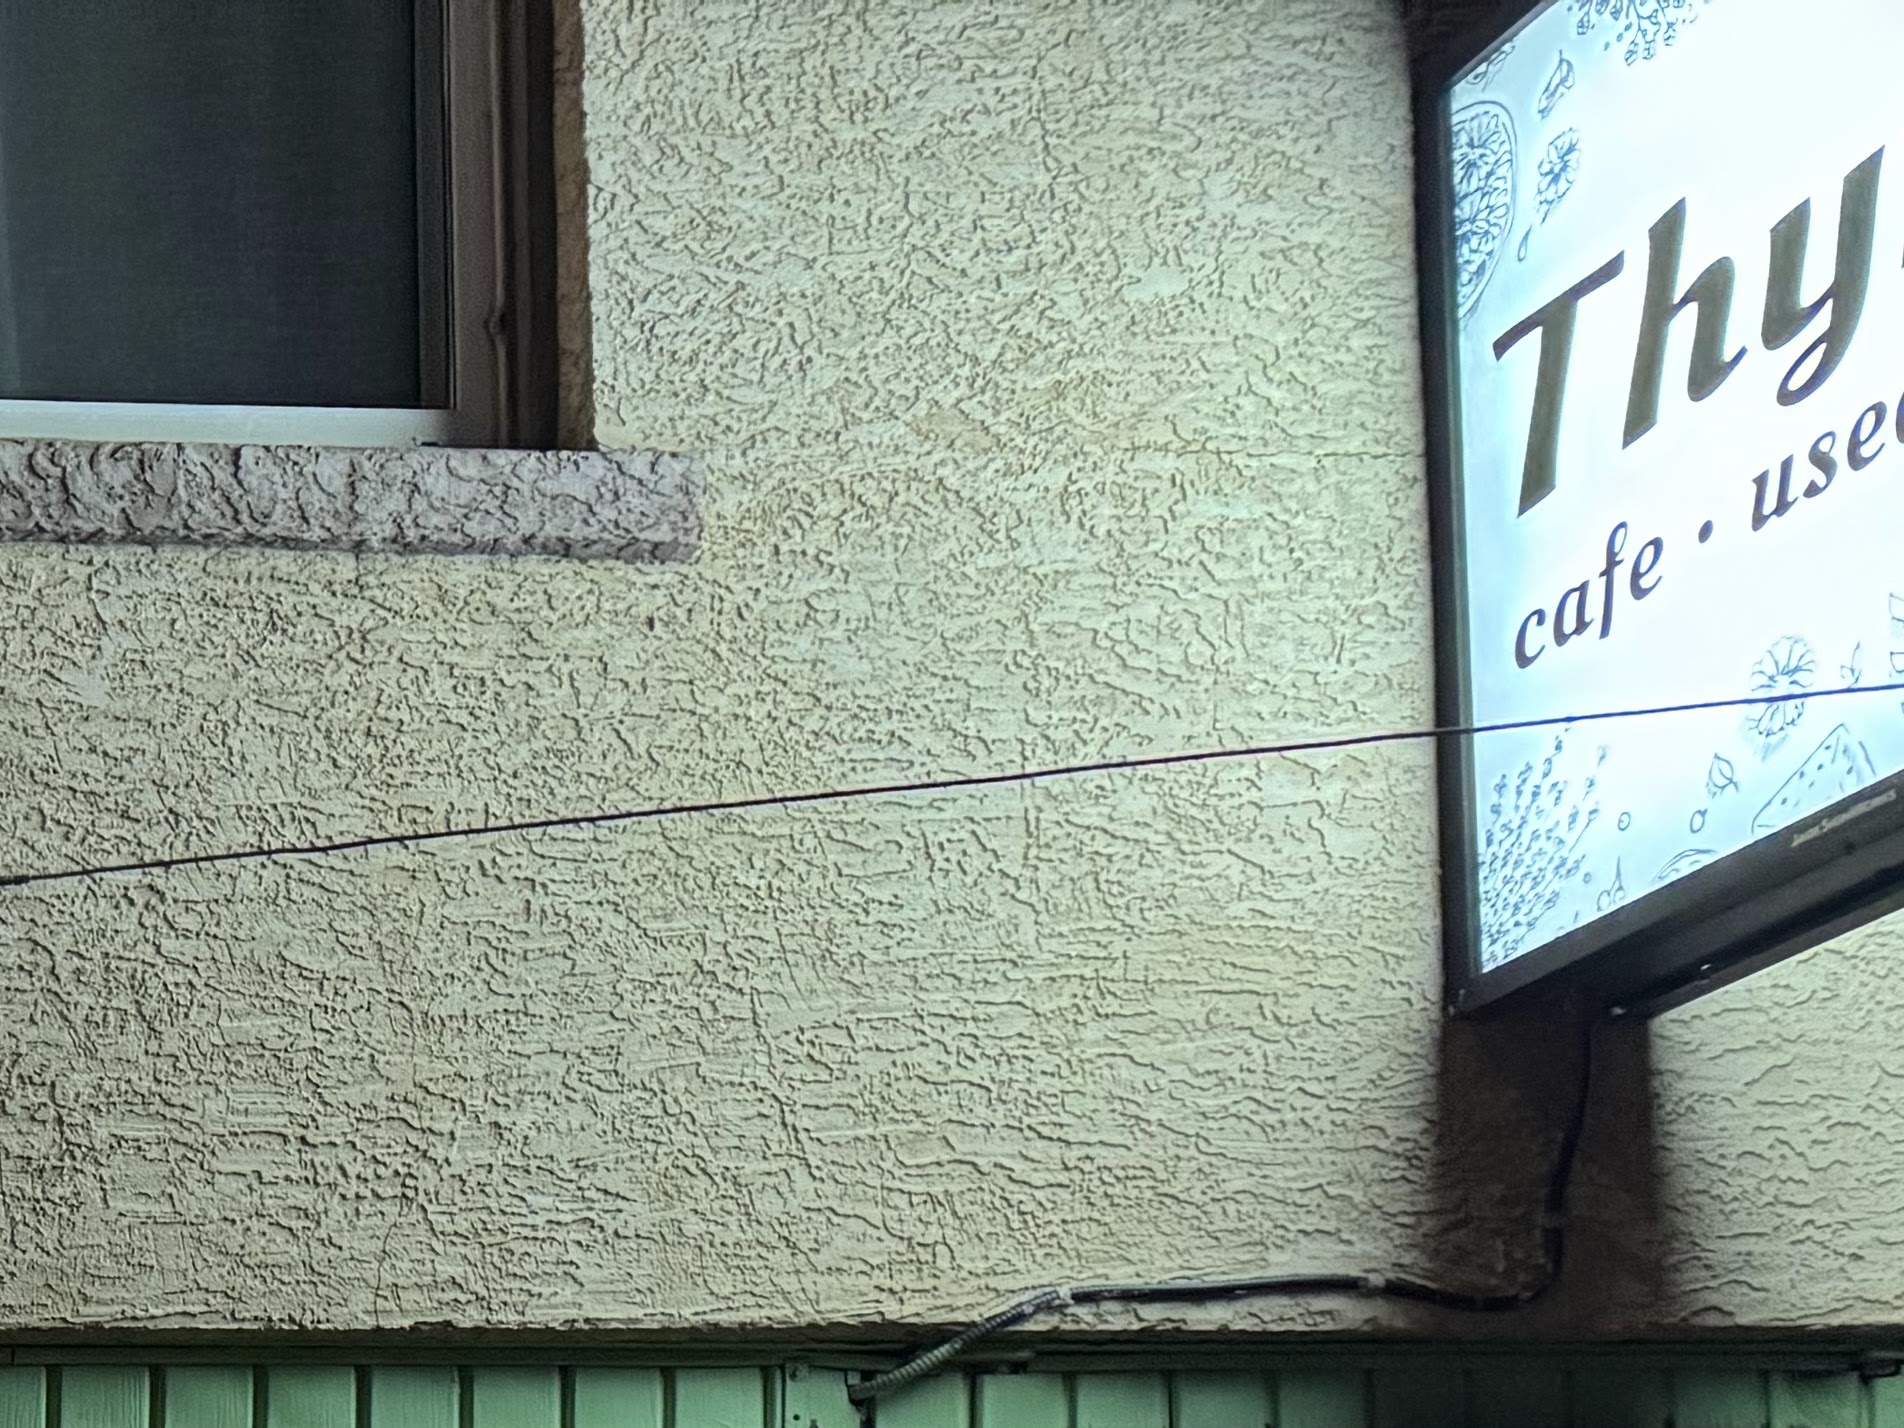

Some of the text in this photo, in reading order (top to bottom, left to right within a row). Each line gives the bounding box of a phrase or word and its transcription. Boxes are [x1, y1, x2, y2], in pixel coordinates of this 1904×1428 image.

[1493, 144, 1904, 518] Thy
[1515, 391, 1904, 669] cafe use
